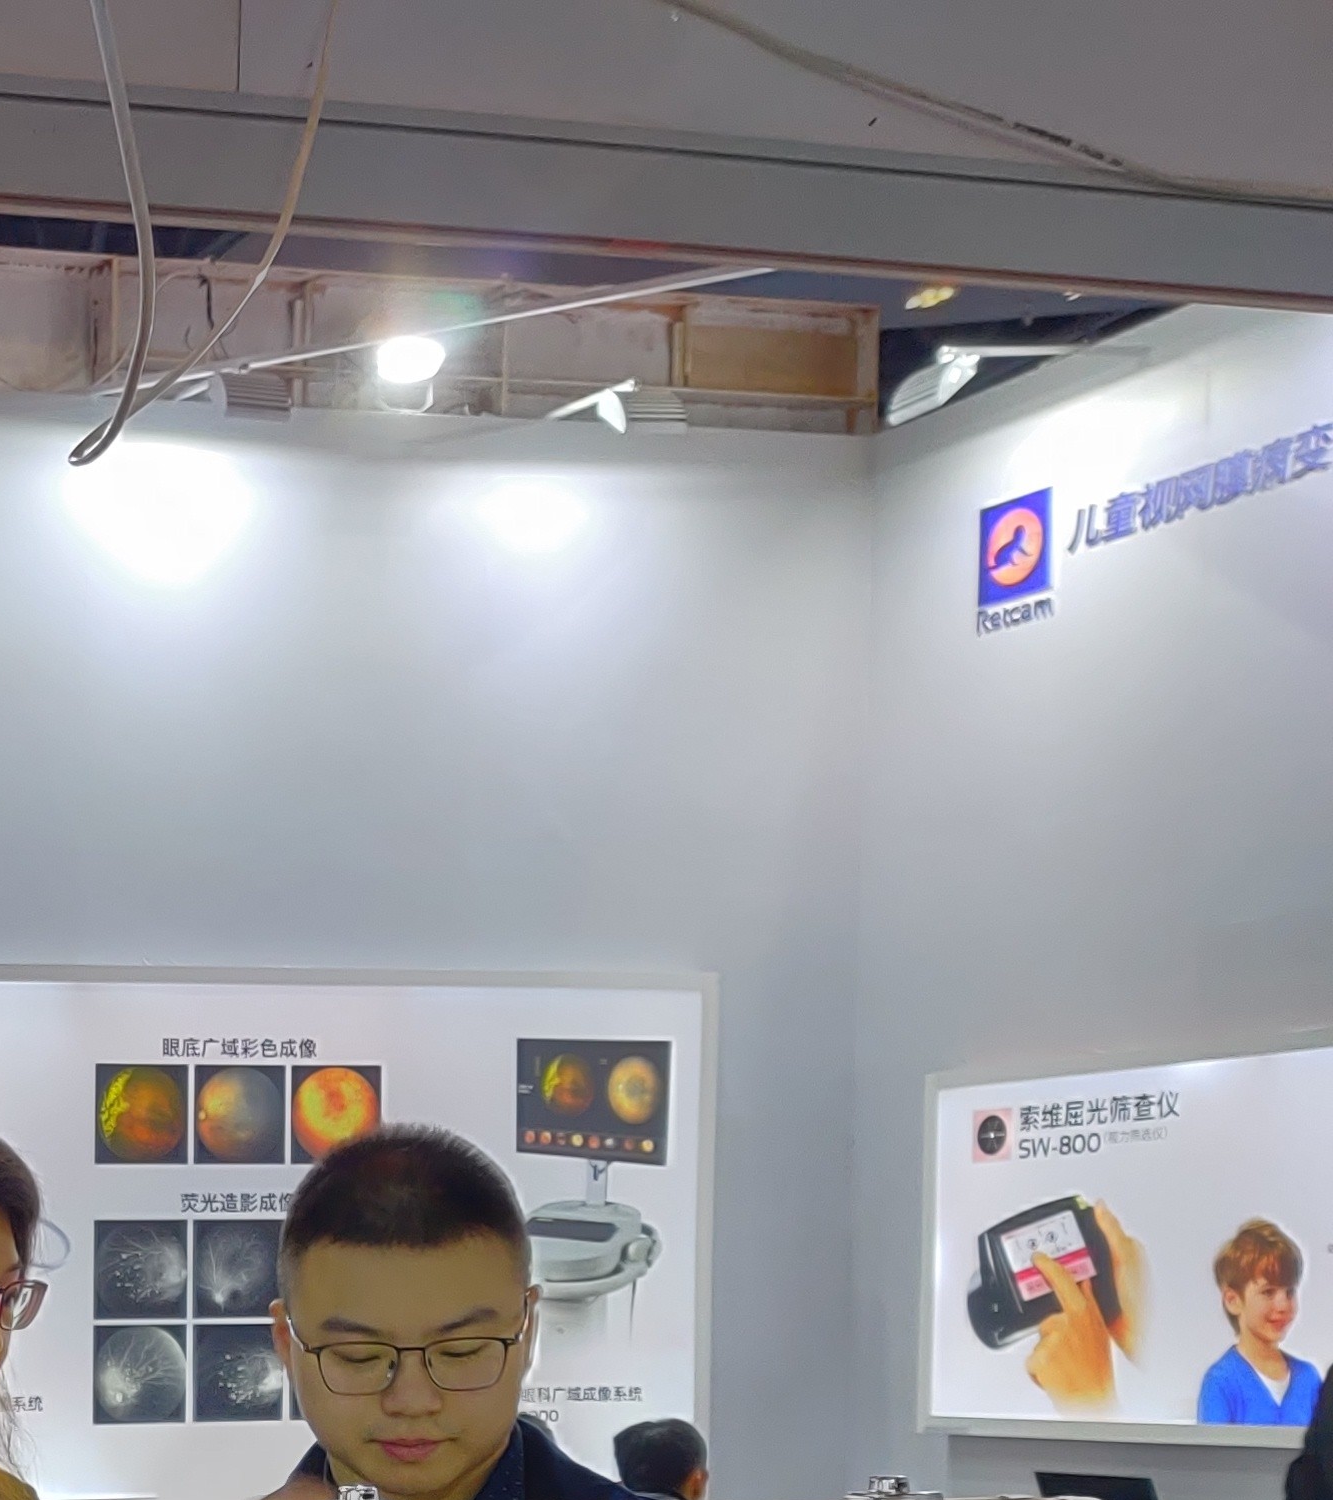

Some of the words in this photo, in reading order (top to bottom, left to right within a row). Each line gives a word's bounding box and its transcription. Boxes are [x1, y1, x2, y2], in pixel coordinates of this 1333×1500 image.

[162, 1038, 317, 1059] 眼底广域彩色成像
[1019, 1090, 1181, 1133] 索维屈光筛查仪
[1018, 1132, 1102, 1160] SW-800
